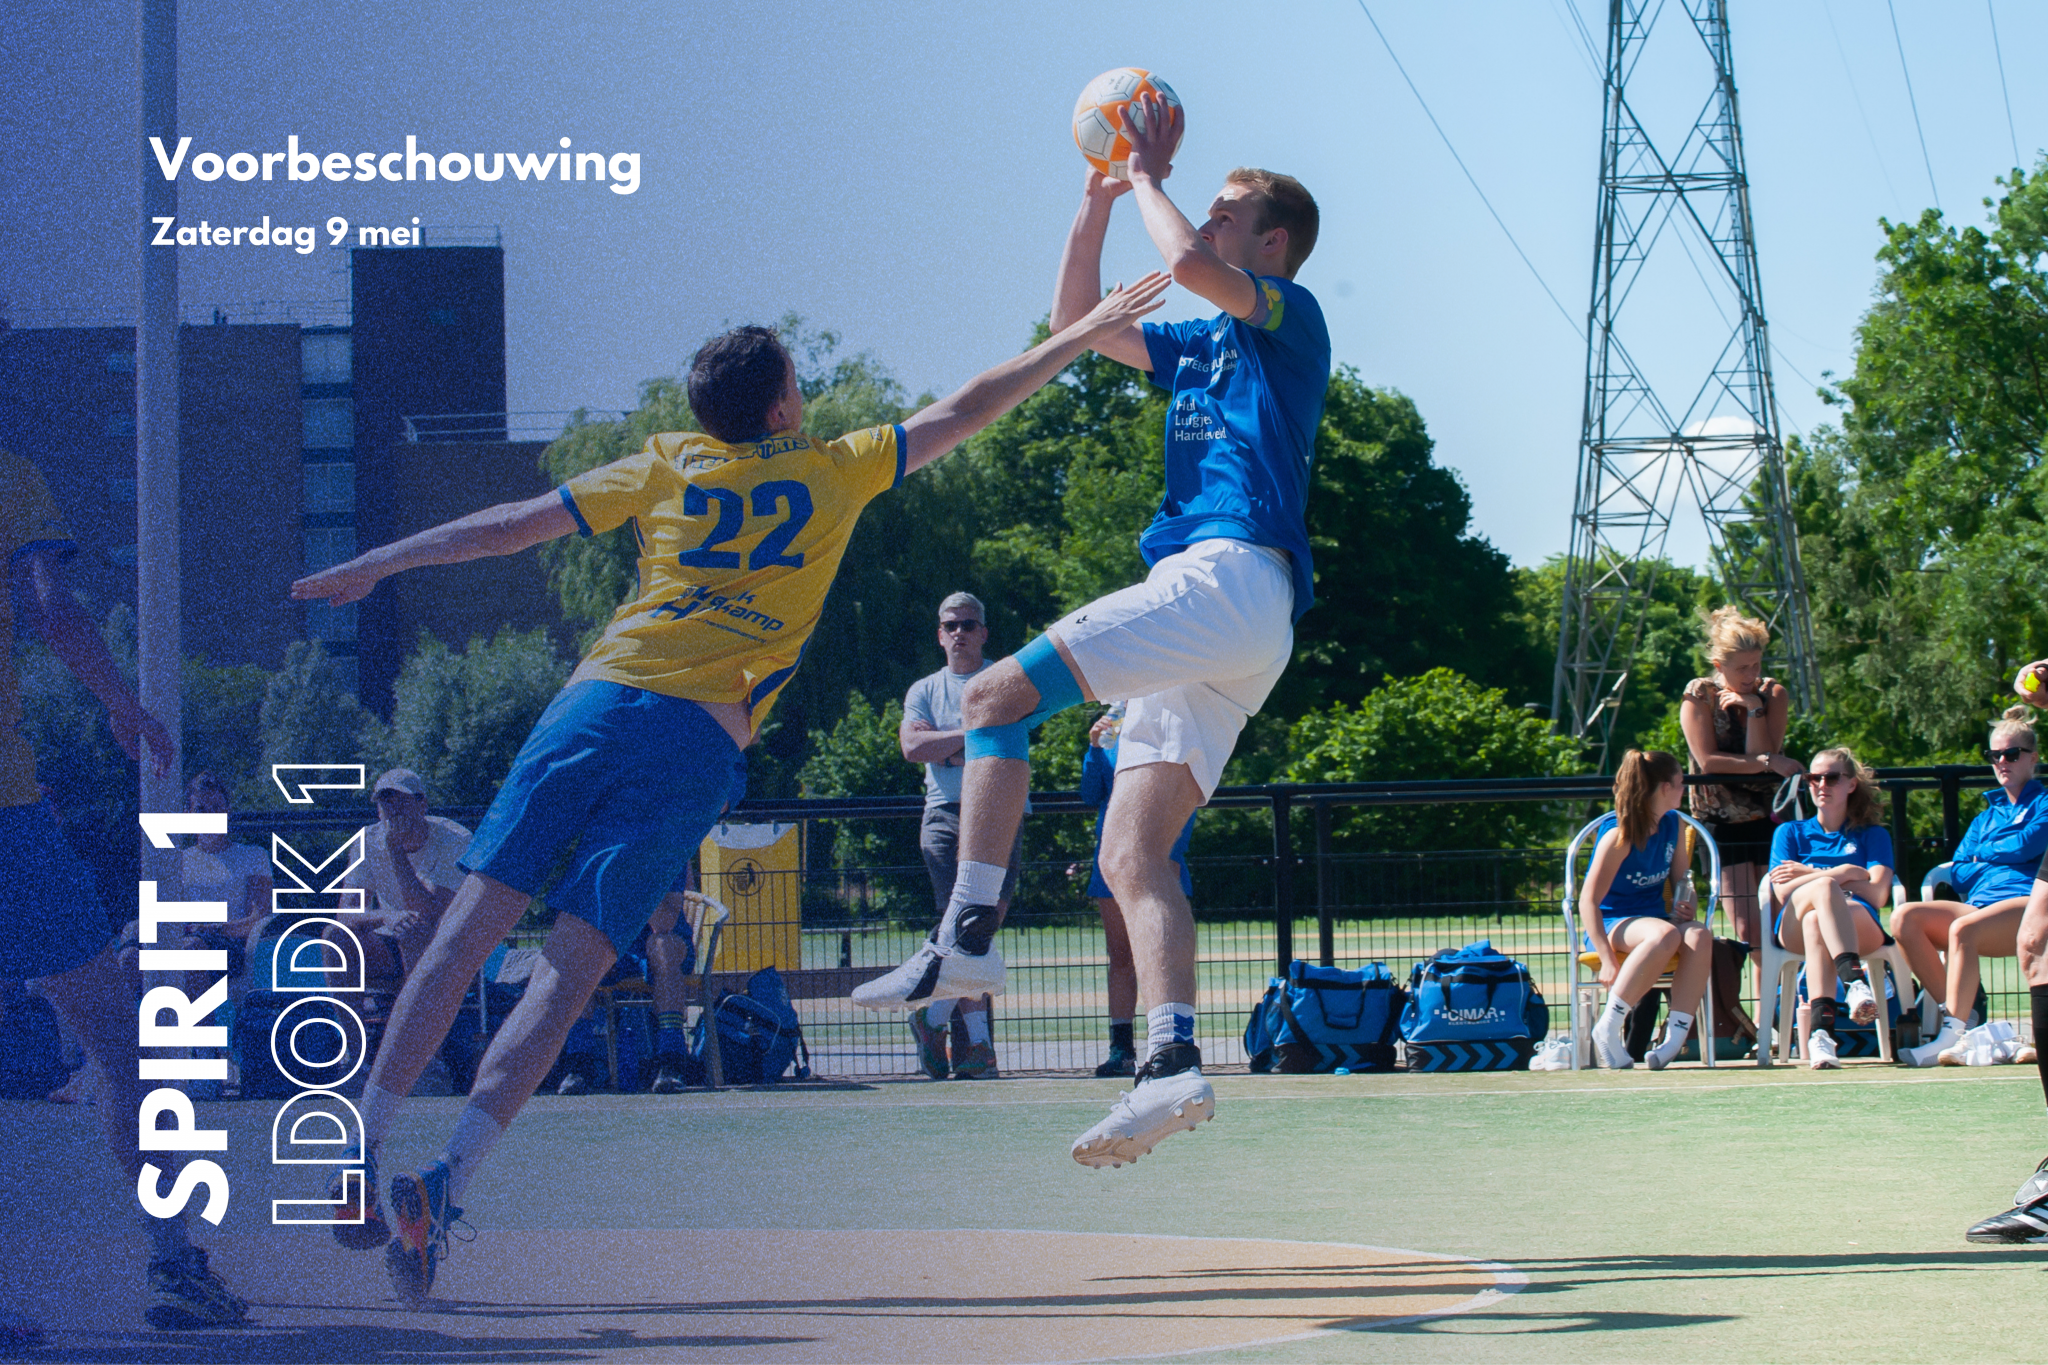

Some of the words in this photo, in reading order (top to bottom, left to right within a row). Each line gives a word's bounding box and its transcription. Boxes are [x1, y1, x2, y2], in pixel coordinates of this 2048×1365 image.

[1175, 414, 1213, 428] Luigjes
[678, 479, 815, 571] 22
[1448, 1007, 1498, 1022] CIMAR
